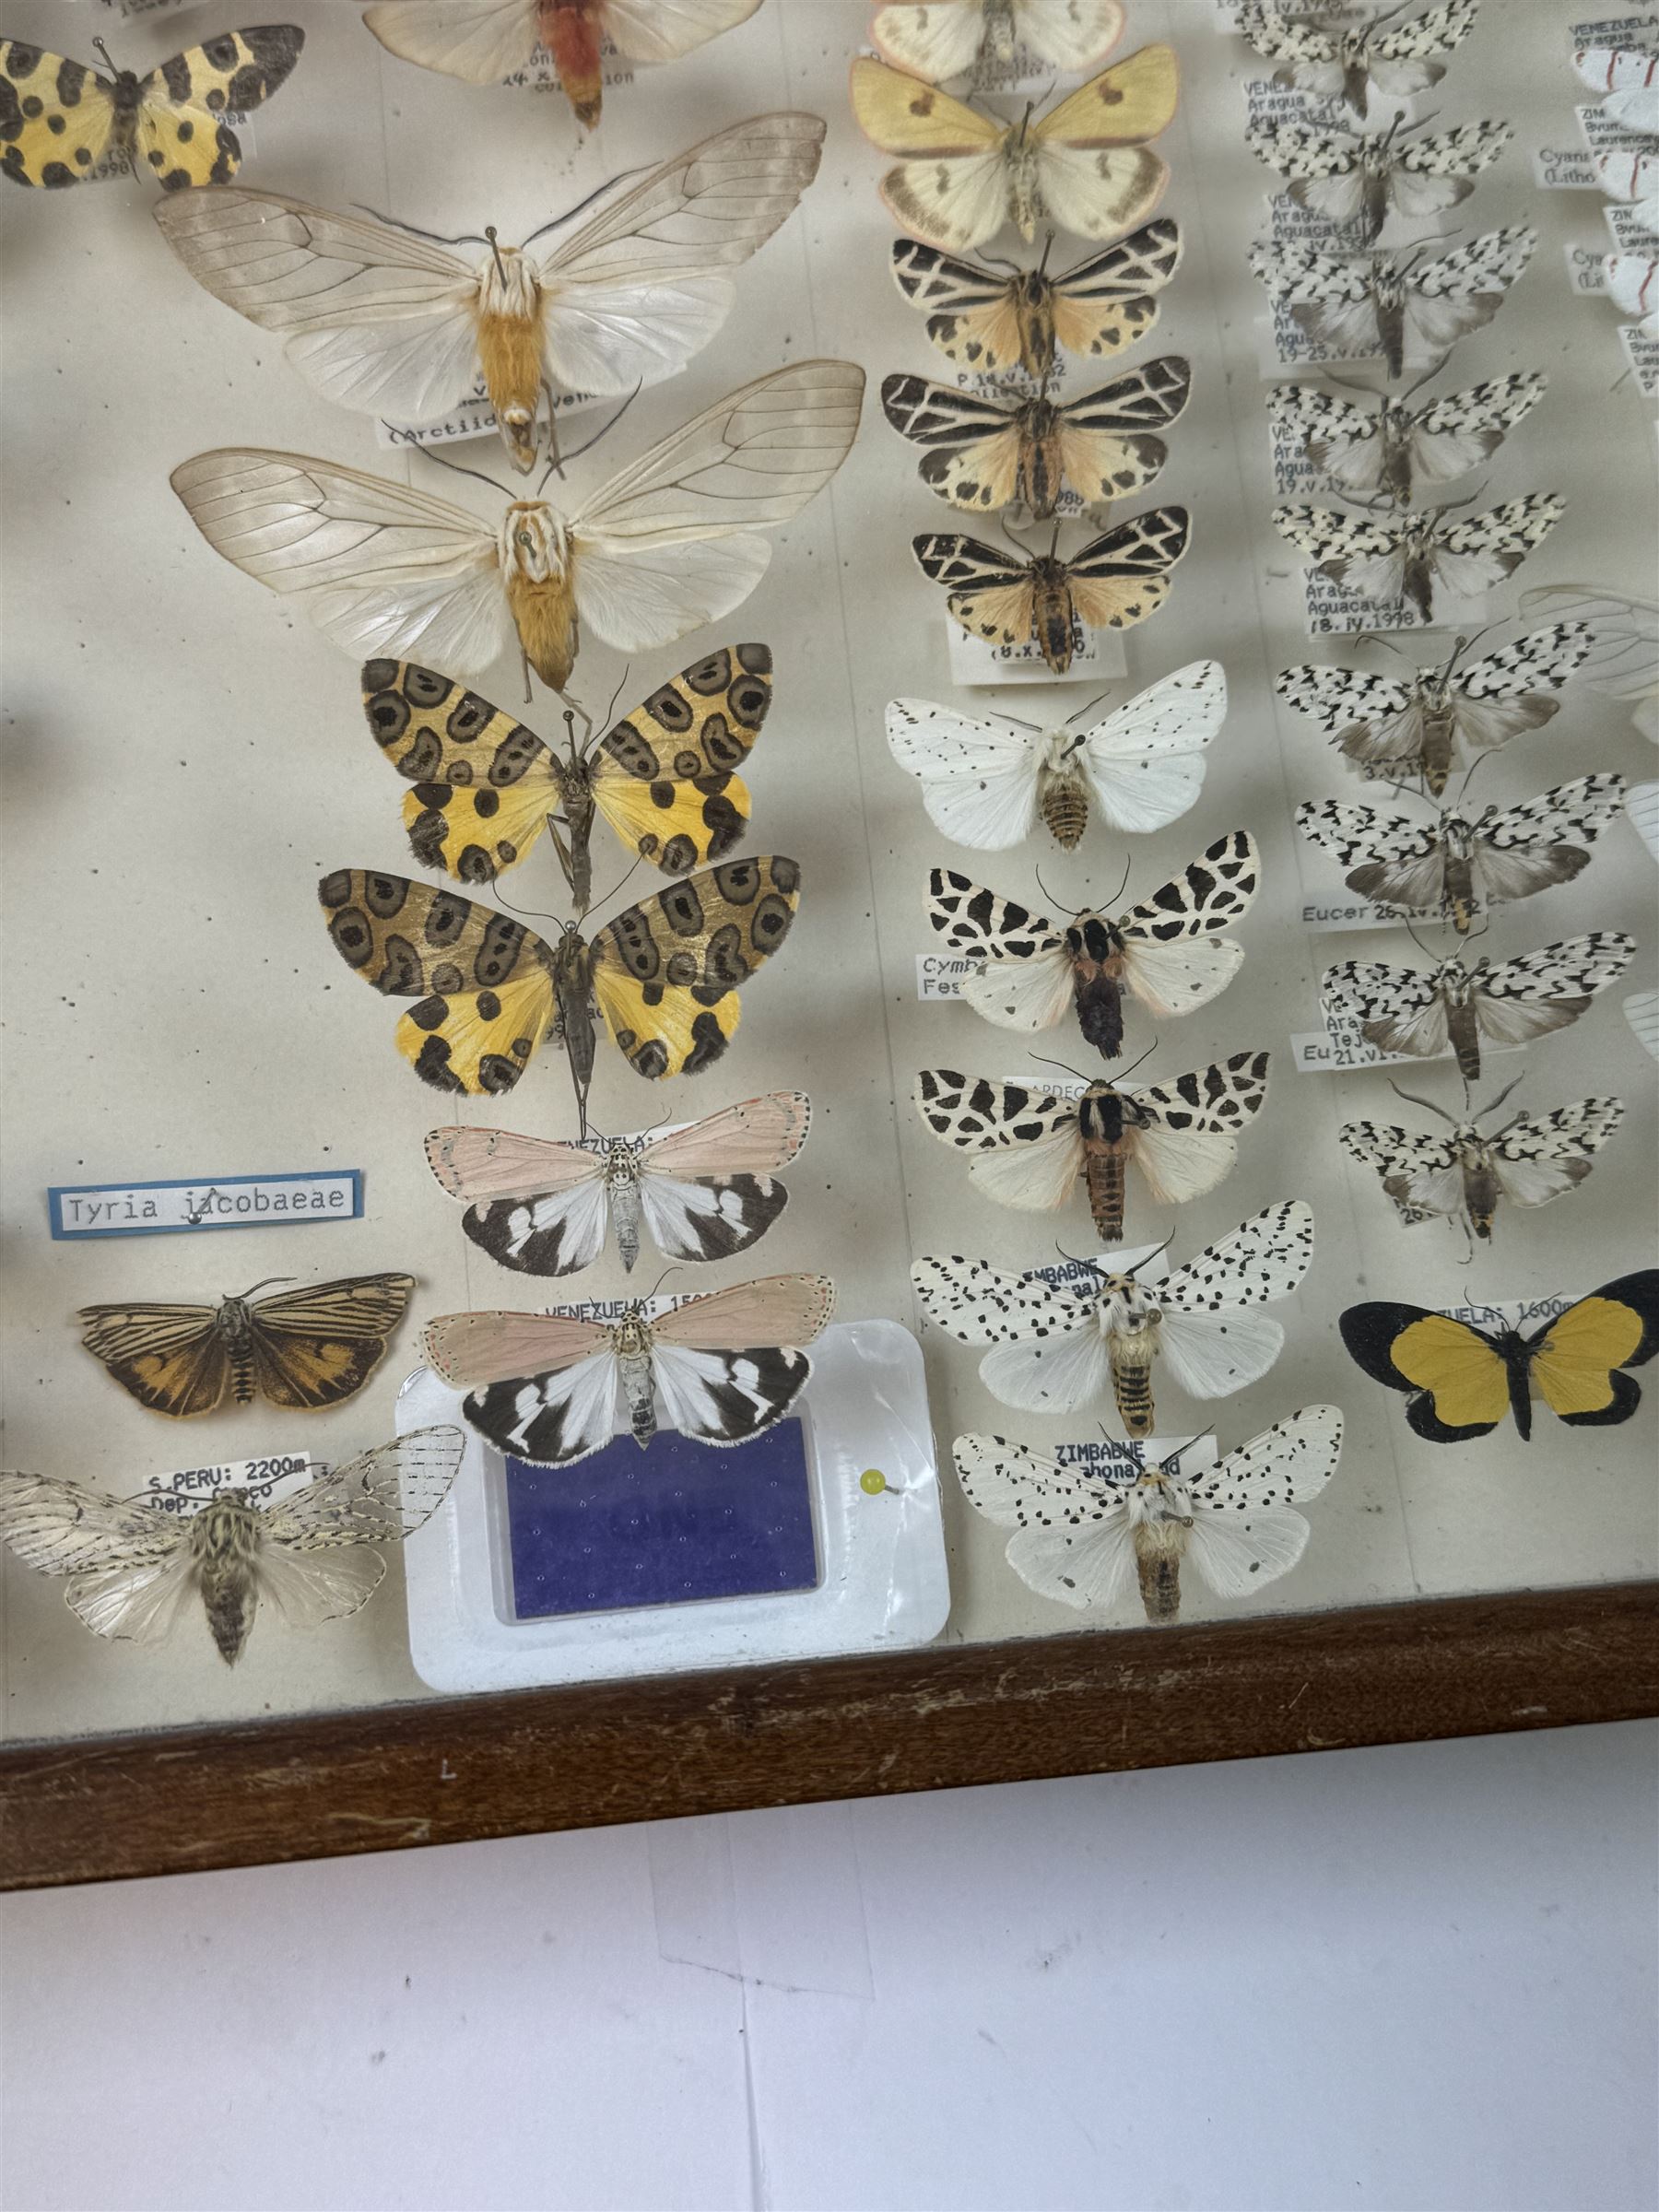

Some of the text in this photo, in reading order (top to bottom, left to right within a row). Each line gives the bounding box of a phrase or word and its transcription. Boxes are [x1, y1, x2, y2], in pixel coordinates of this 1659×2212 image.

[924, 978, 960, 994] Fes
[1327, 1015, 1359, 1032] Ara
[1329, 1029, 1363, 1049] Tej
[1303, 1044, 1330, 1060] Eu
[68, 1187, 345, 1226] Tyria jacobaeae
[1054, 1440, 1146, 1464] ZIMBABWE
[245, 1456, 307, 1481] 2200m
